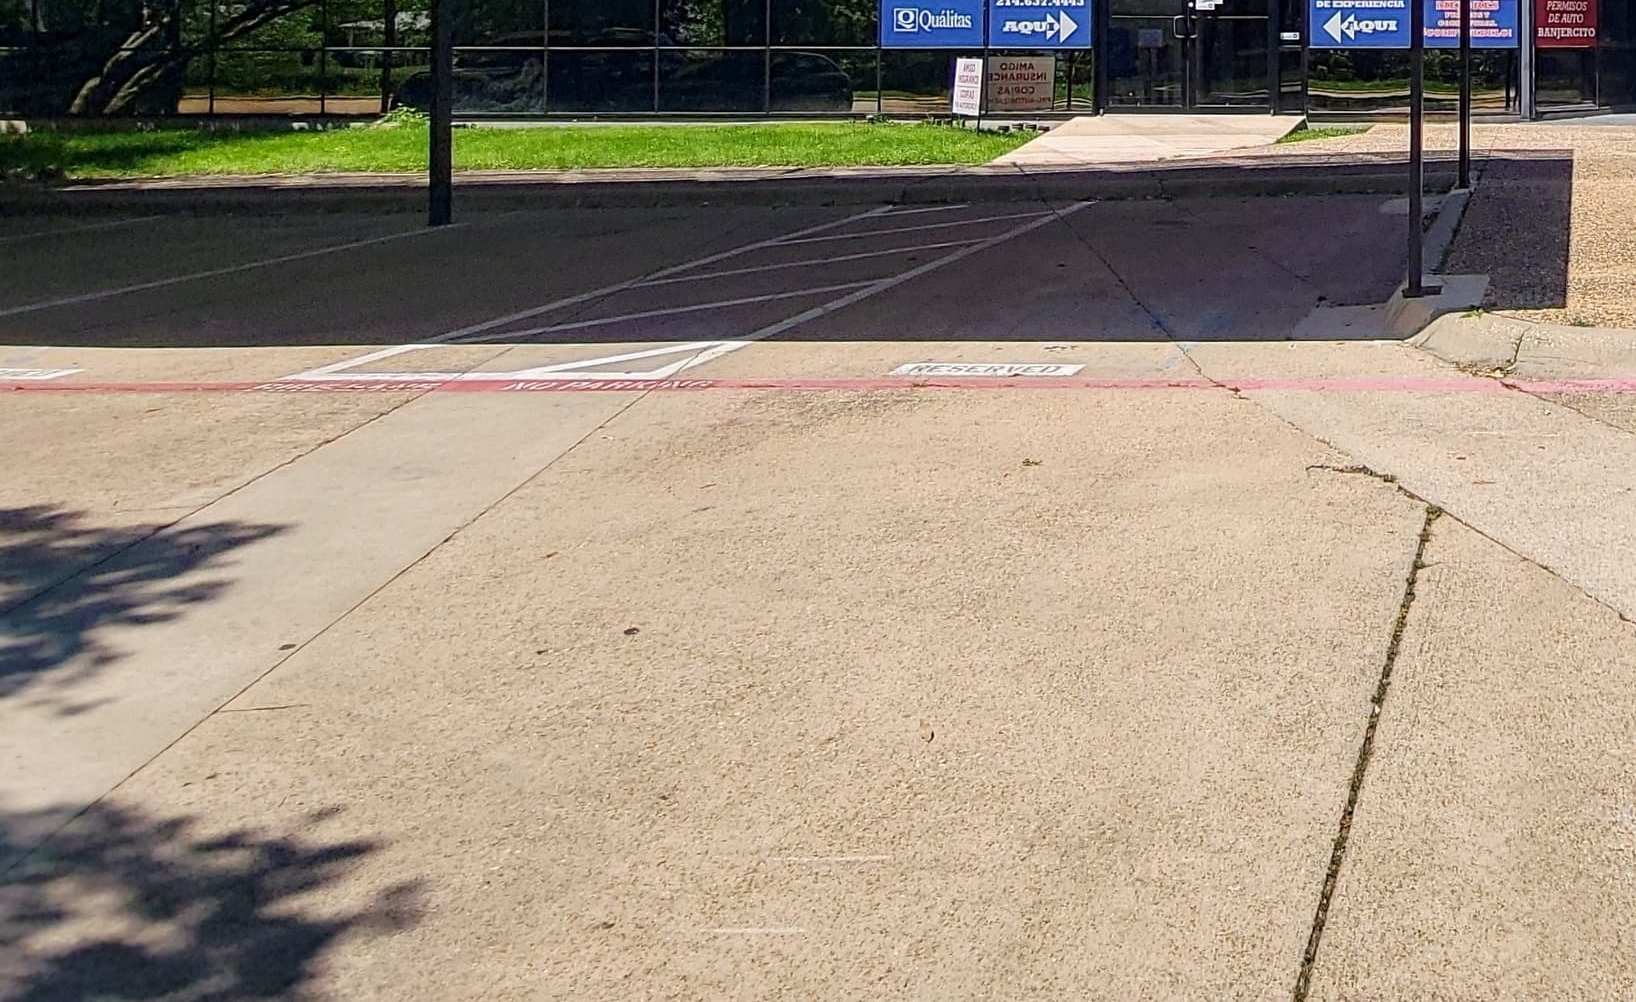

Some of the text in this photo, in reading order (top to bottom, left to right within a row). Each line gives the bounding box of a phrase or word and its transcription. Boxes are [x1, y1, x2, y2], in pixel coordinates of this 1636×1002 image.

[1316, 0, 1405, 8] DE EXPERIENCIA
[1546, 0, 1588, 11] PERMISOS
[919, 9, 972, 32] Quálitas
[1548, 13, 1584, 23] DE AUTO
[1537, 27, 1596, 39] BANJERCITO
[907, 364, 1064, 374] RESERVED
